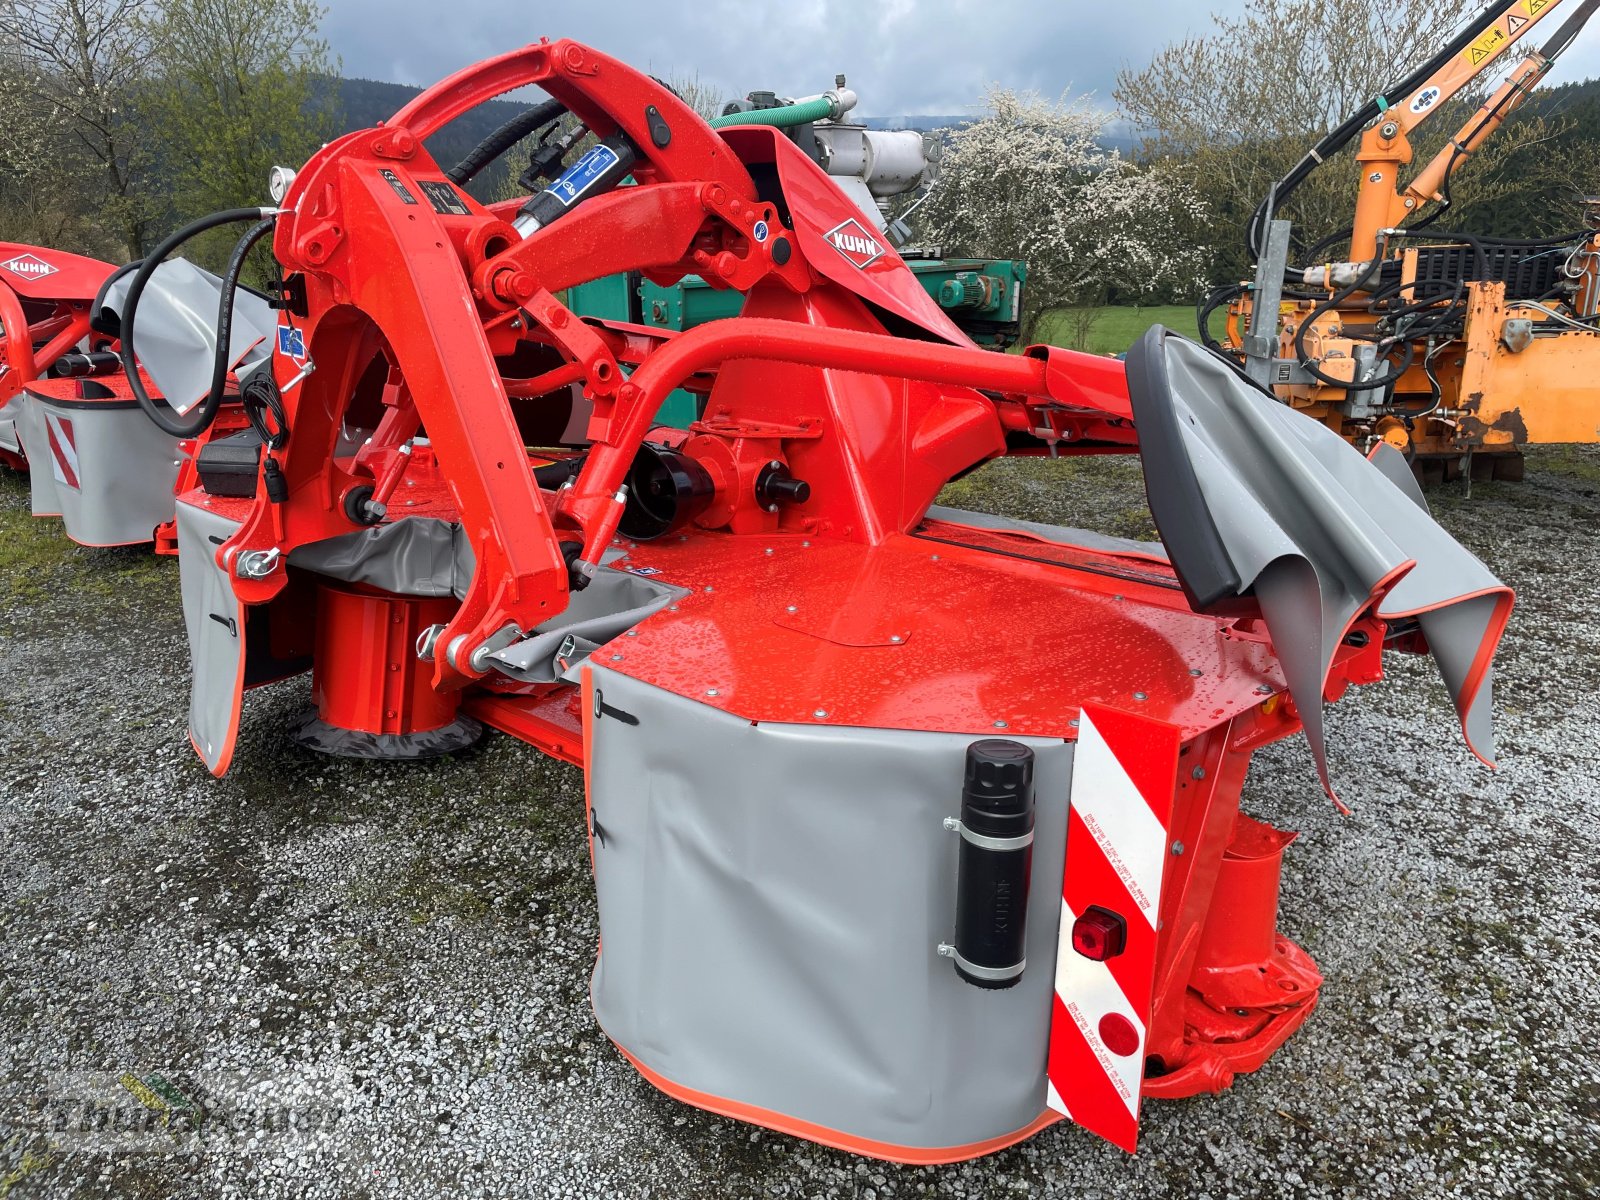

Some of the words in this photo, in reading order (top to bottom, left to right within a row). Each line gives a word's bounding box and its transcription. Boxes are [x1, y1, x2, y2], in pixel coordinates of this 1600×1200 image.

[833, 232, 877, 256] KUHN
[10, 261, 49, 274] KUHN
[995, 880, 1010, 933] KUHN
